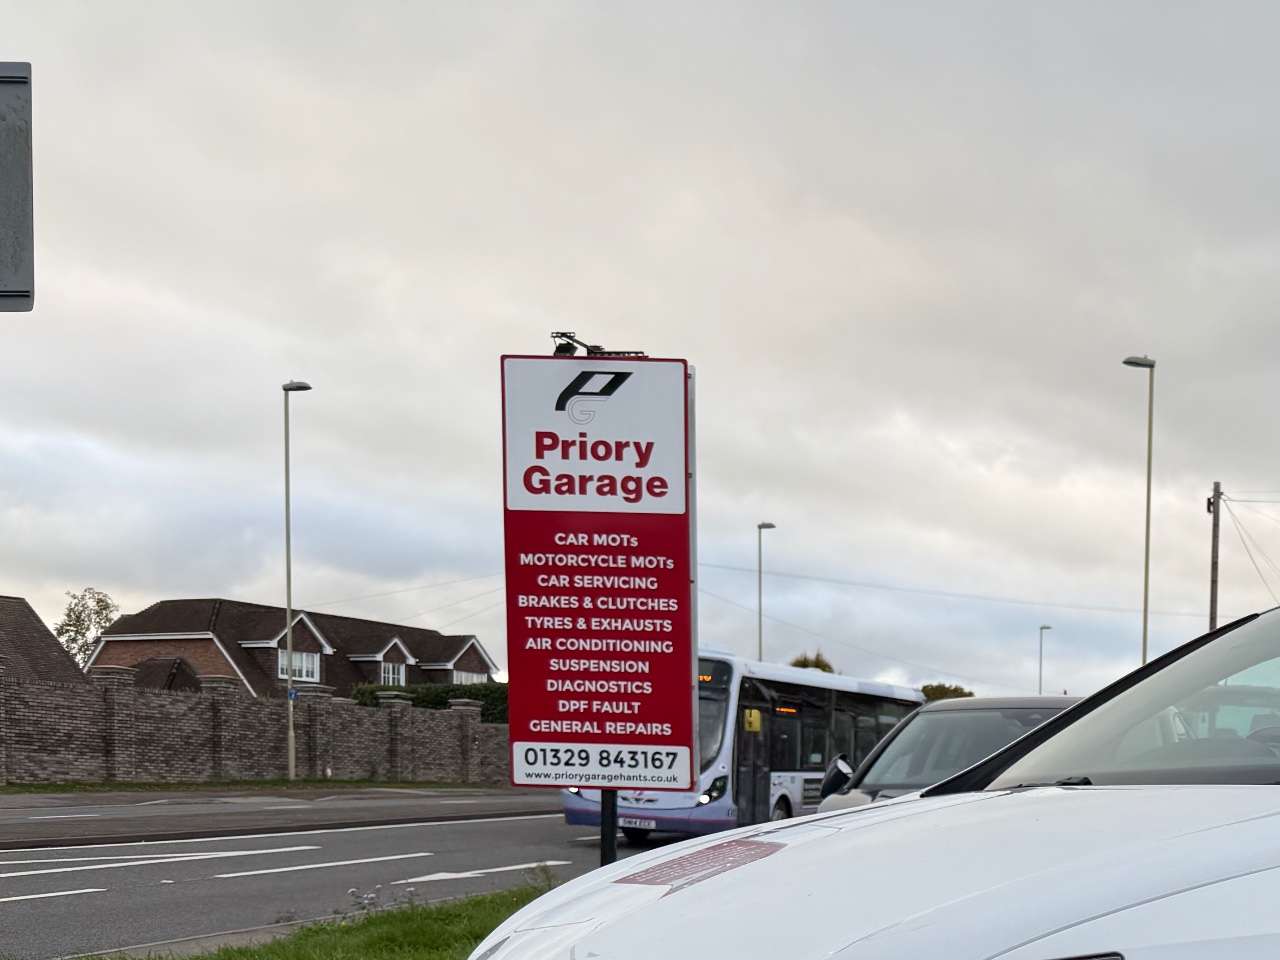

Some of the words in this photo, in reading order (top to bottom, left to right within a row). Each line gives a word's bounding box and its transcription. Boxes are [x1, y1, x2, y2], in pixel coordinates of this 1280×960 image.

[535, 431, 655, 468] Priory
[523, 465, 669, 503] Garage
[554, 532, 589, 546] CAR
[593, 534, 639, 547] MOTs
[519, 553, 627, 568] MOTORCYCLE
[631, 555, 675, 570] MOTs
[537, 575, 570, 588] CAR
[574, 576, 658, 590] SERVICING
[518, 595, 579, 609] BRAKES
[583, 596, 593, 609] &
[597, 597, 679, 611] CLUTCHES
[525, 616, 573, 630] TYRES
[577, 617, 587, 630] &
[591, 617, 673, 632] EXHAUSTS
[525, 638, 552, 650] AIR
[556, 638, 674, 653] CONDITIONING
[549, 658, 650, 673] SUSPENSION
[546, 679, 653, 694] DIAGNOSTICS
[558, 700, 588, 712] DPF
[592, 701, 641, 714] FAULT
[529, 719, 602, 734] GENERAL
[605, 721, 673, 736] REPAIRS
[524, 748, 590, 766] 01329
[598, 749, 679, 770] 843167
[525, 770, 679, 784] www.priorygaragehants.co.uk
